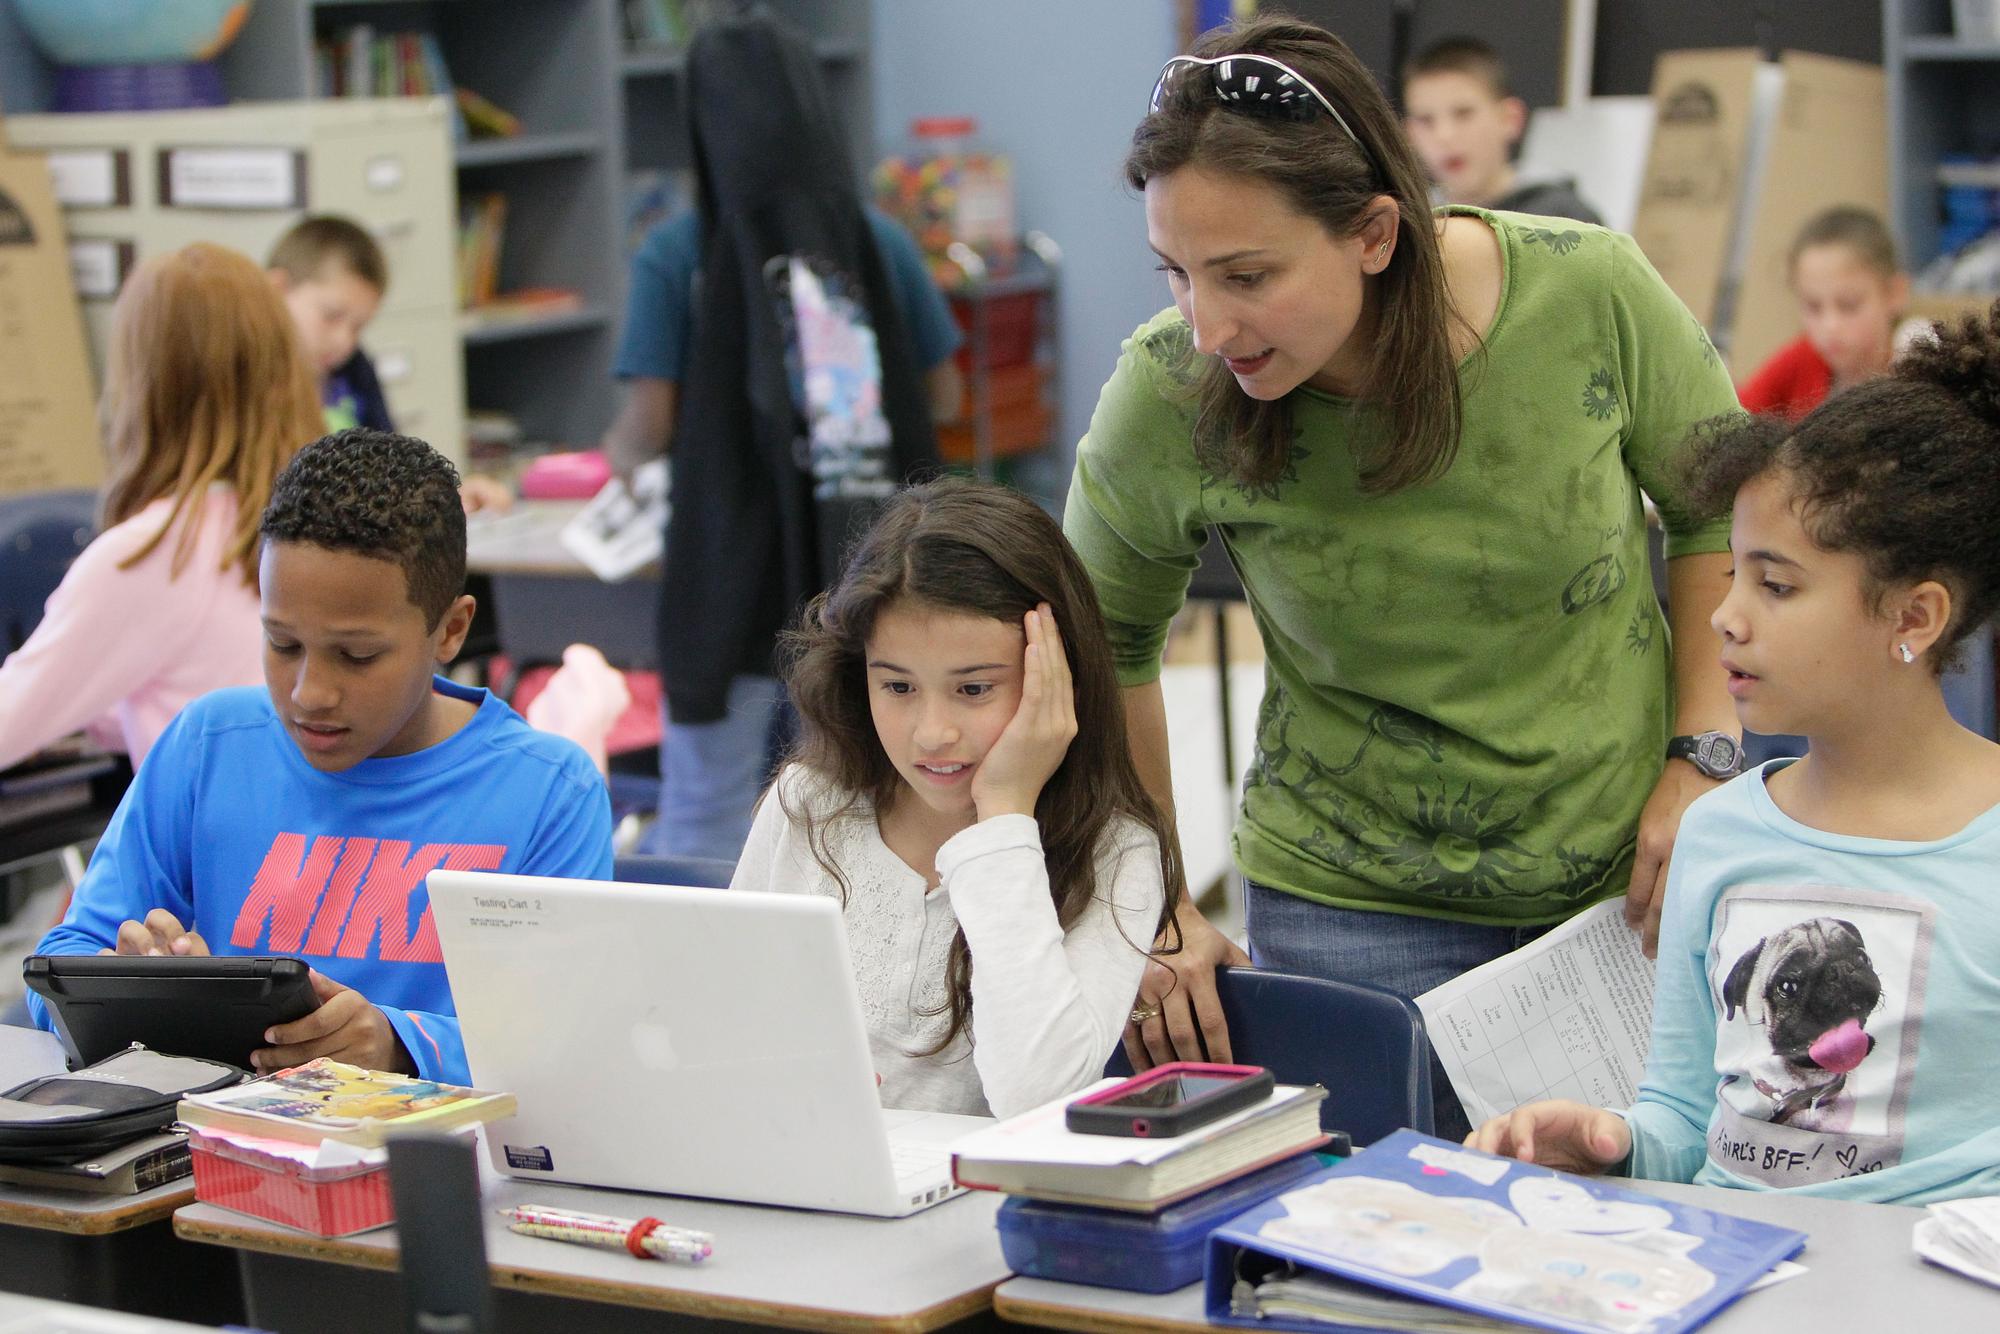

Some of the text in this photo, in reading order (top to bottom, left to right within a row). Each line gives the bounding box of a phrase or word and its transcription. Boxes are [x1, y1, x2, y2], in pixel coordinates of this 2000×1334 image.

[473, 896, 543, 910] Testing Cart 2
[1762, 1143, 1824, 1171] BFF!
